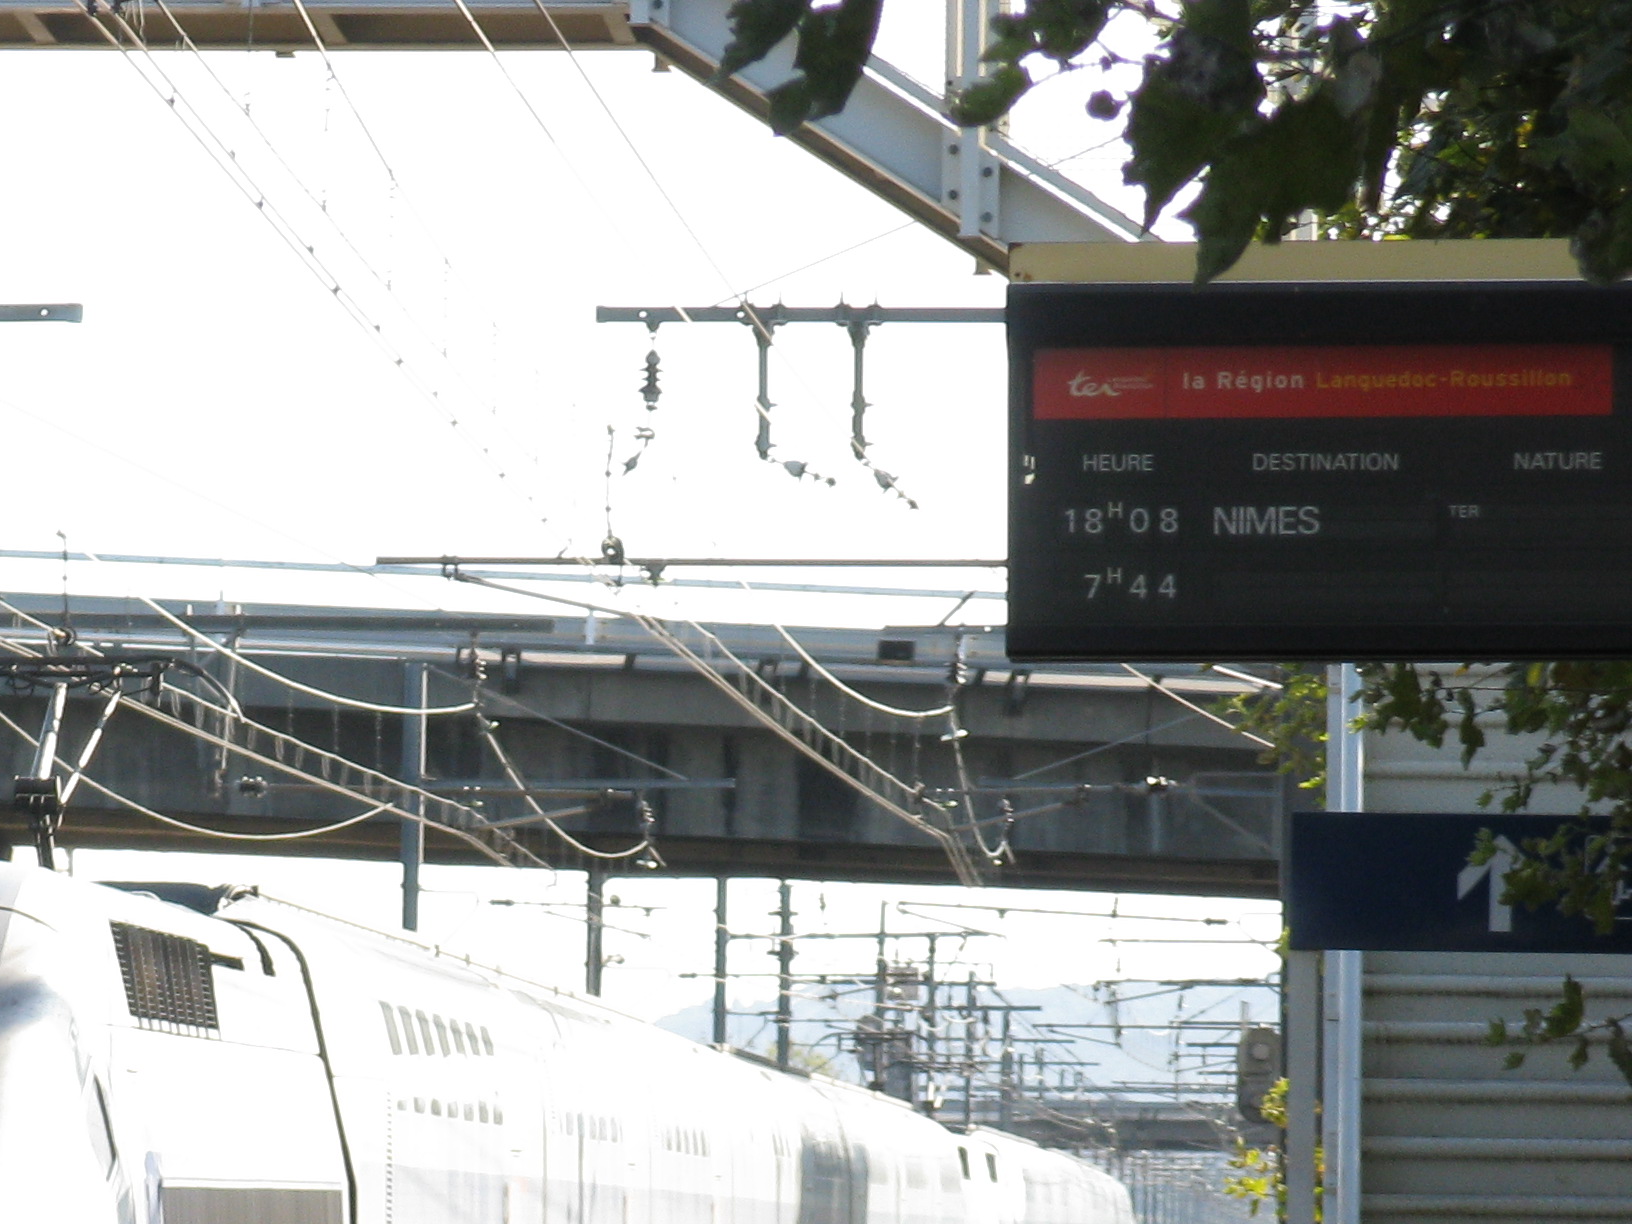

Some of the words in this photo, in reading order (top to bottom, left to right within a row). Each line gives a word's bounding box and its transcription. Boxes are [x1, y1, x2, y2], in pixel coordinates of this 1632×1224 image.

[1067, 371, 1120, 396] ter
[1182, 372, 1205, 389] la
[1217, 370, 1304, 392] Région
[1316, 369, 1571, 391] Languedoc-Roussillon
[1083, 454, 1155, 471] HEURE
[1252, 452, 1400, 471] DESTINATION
[1512, 452, 1604, 470] NATURE
[1212, 506, 1320, 535] NIMES
[1447, 504, 1480, 518] TER
